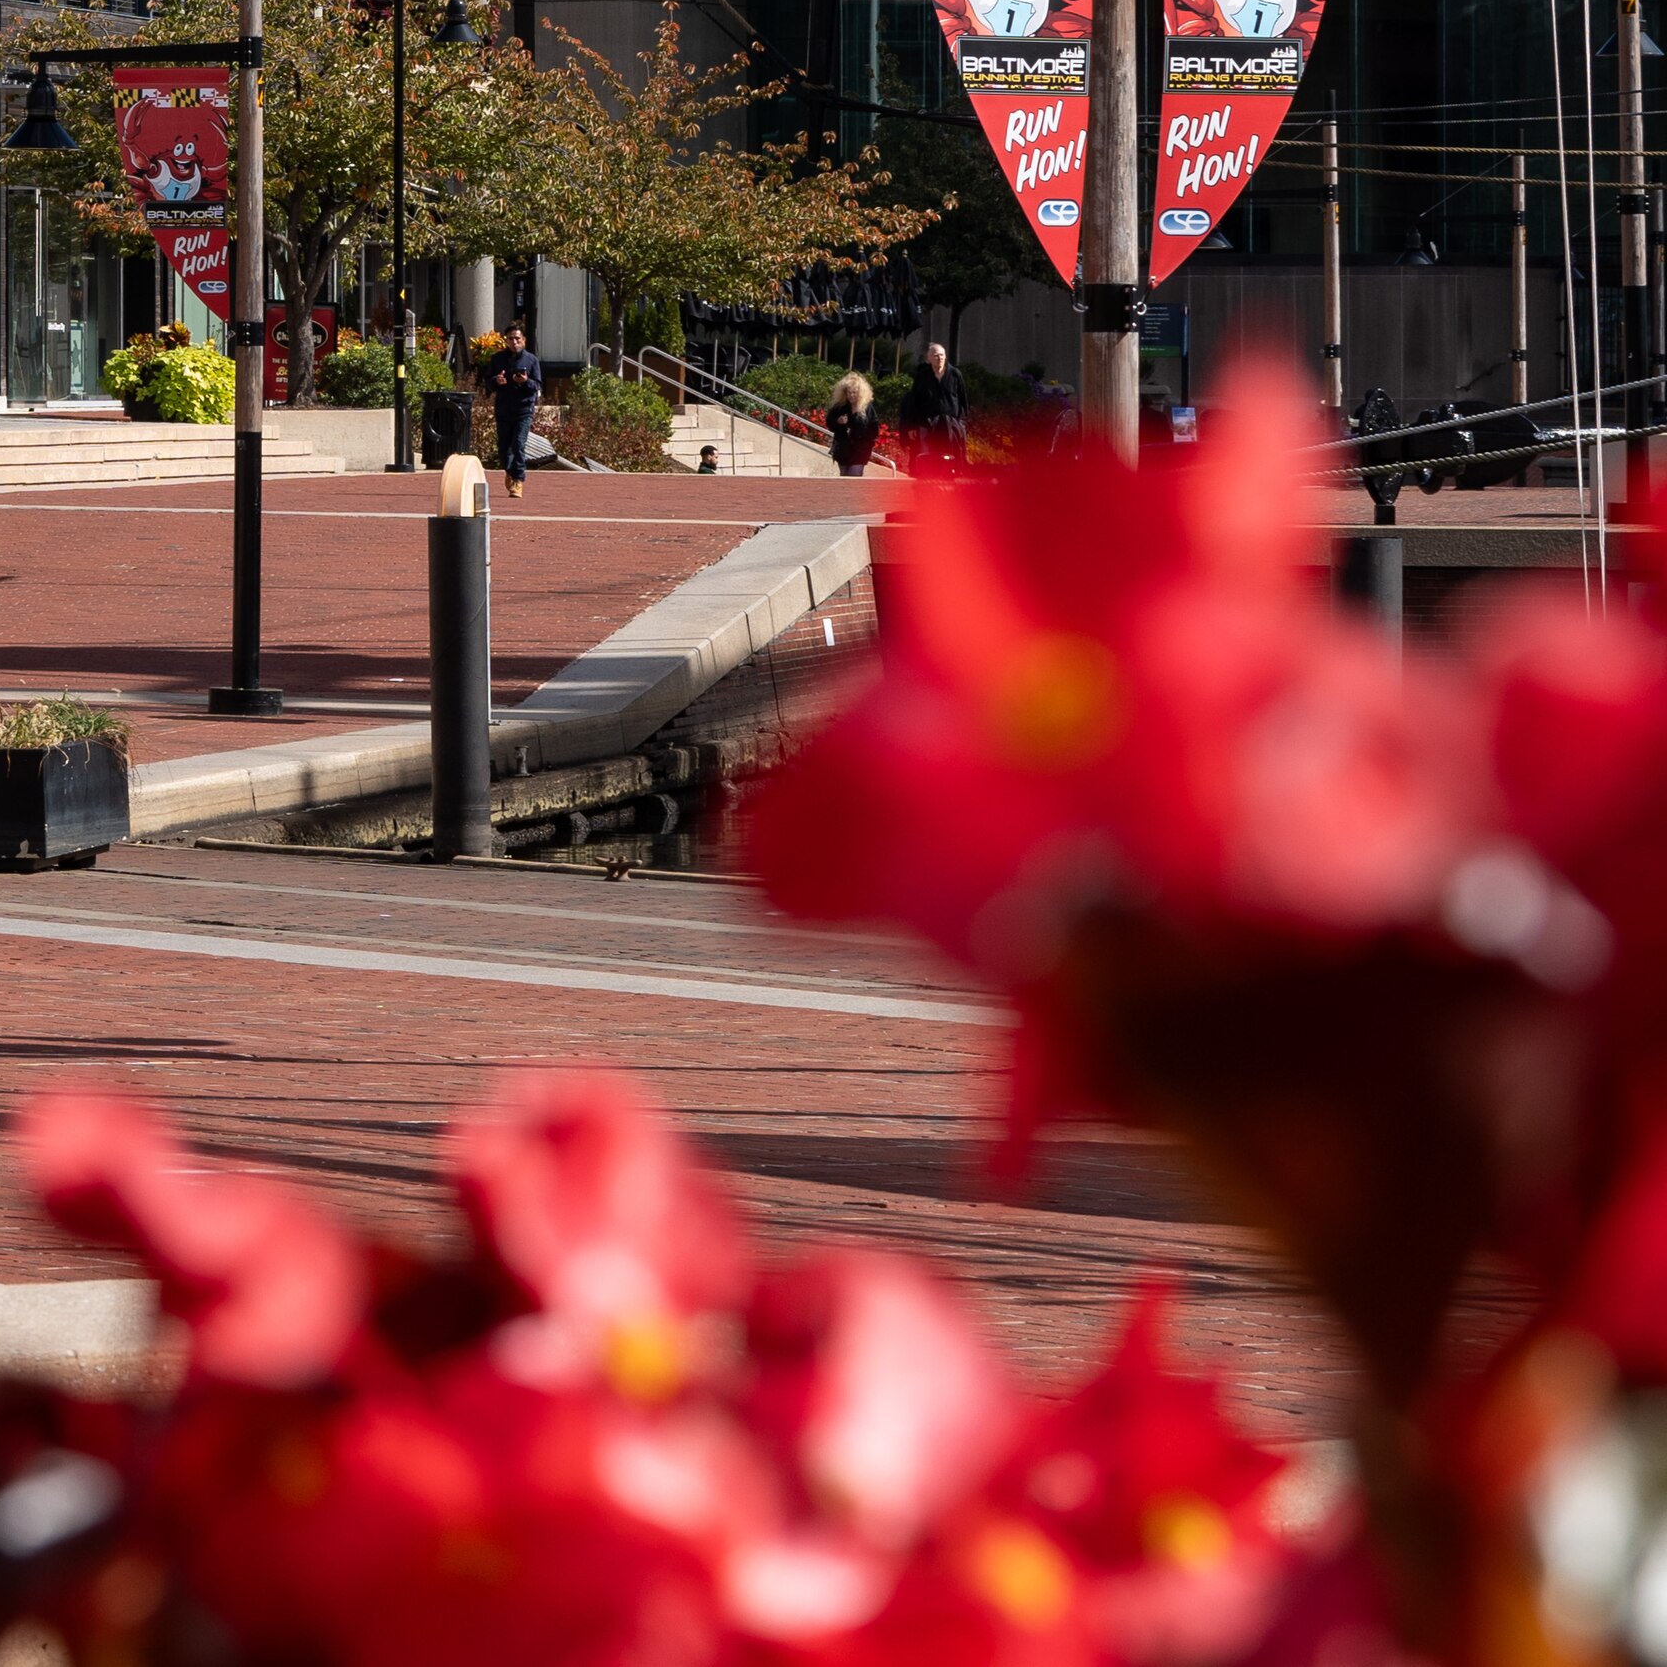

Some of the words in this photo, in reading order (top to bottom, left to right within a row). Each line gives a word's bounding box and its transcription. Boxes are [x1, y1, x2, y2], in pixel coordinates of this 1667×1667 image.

[1006, 9, 1015, 33] 1
[1253, 10, 1263, 34] 1
[962, 56, 1085, 75] BALTIMORE
[1170, 57, 1298, 74] BALTIMORE
[963, 73, 1021, 82] RUNNING
[1024, 75, 1083, 83] FESTIVAL
[1170, 73, 1230, 82] RUNNING
[1234, 74, 1298, 83] FESTIVAL
[1004, 99, 1063, 152] RUN
[1165, 104, 1232, 158] RUN
[1016, 129, 1087, 194] HON!
[1176, 134, 1259, 198] HON!
[173, 187, 180, 199] 1
[147, 211, 224, 219] BALTIMORE
[173, 231, 210, 258] RUN
[182, 246, 227, 278] HON!
